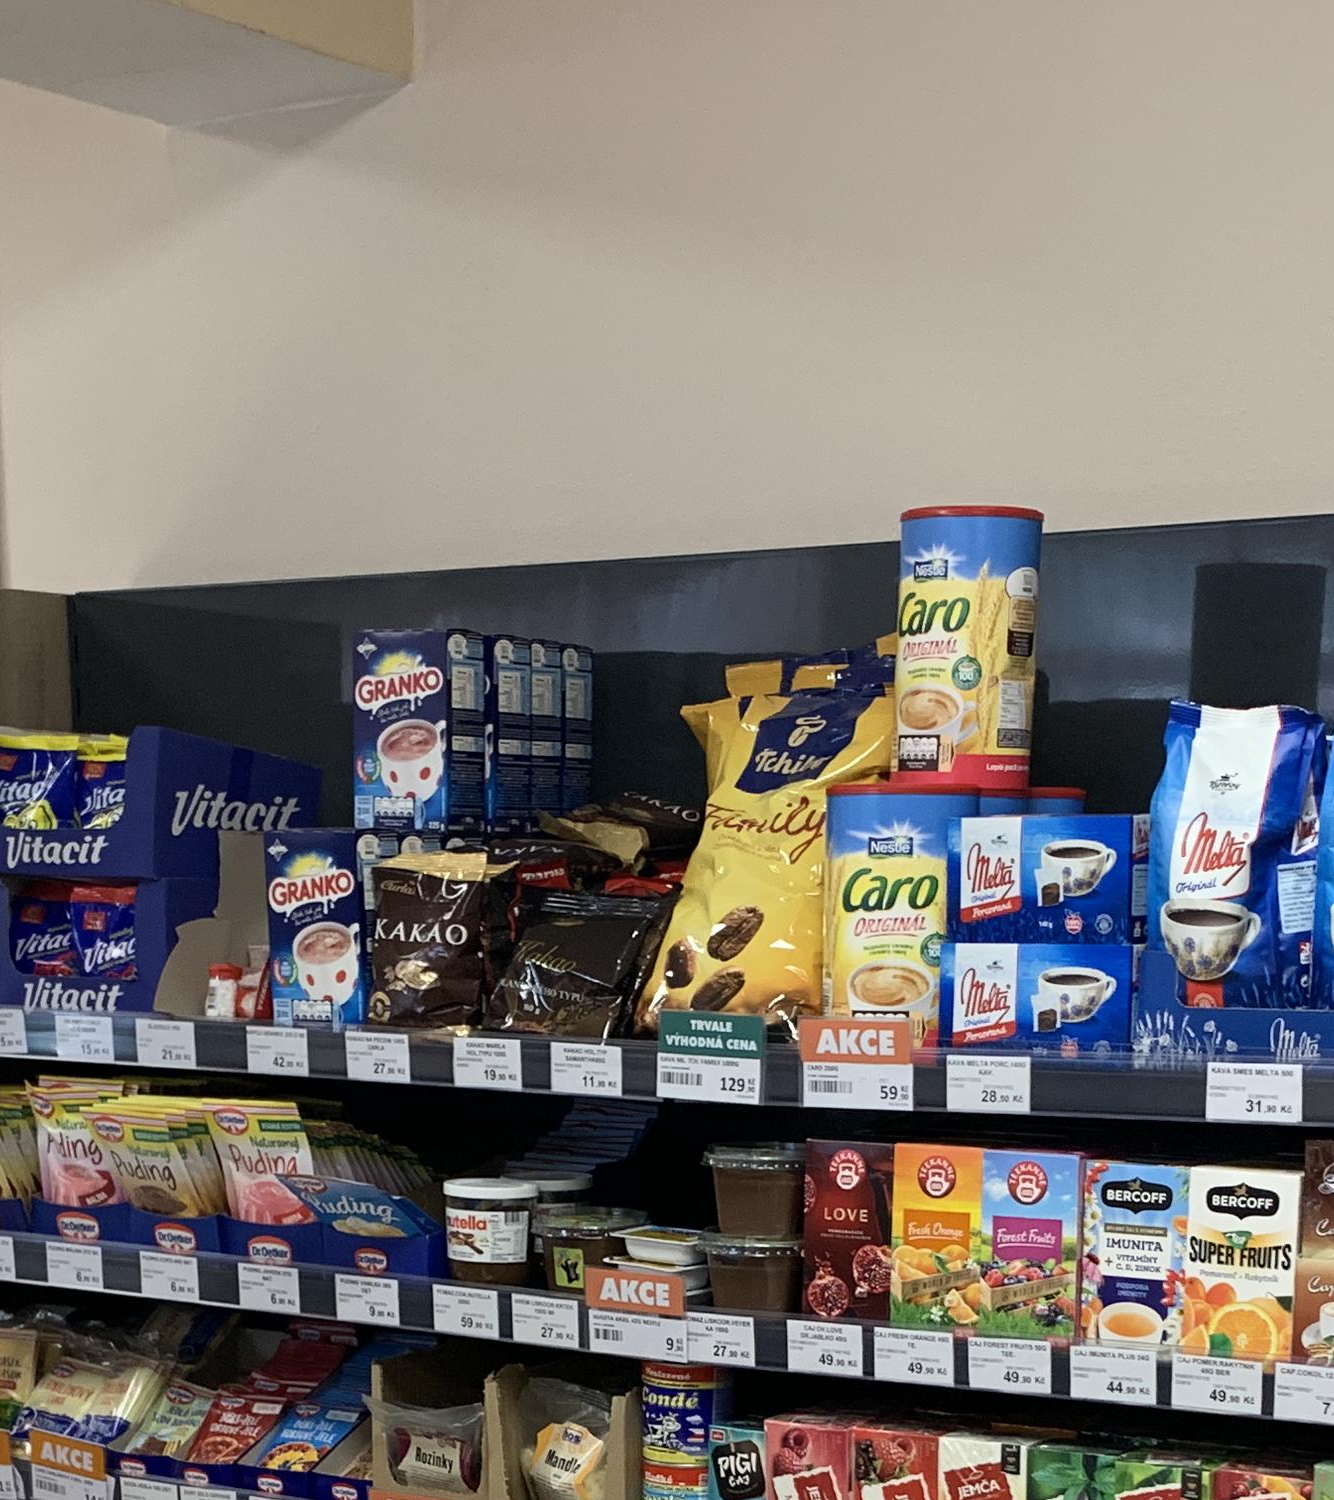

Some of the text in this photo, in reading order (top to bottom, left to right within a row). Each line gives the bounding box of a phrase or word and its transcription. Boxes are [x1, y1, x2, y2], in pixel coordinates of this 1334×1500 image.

[898, 592, 969, 636] Caro
[903, 637, 957, 661] ORIGINÁL
[358, 667, 441, 704] GRANKO
[171, 785, 300, 837] Vitacit
[706, 796, 826, 864] Family
[5, 834, 109, 870] Vitacit
[1181, 811, 1250, 887] Melta
[967, 842, 1015, 904] Melta
[271, 871, 353, 908] GRANKO
[842, 868, 939, 913] Caro
[375, 917, 466, 945] KAKAO
[854, 914, 927, 936] ORIGINÁL
[690, 1019, 733, 1034] TRVALE
[666, 1034, 757, 1052] VÝHODNÁ CENA
[816, 1029, 894, 1056] AKCE
[720, 1077, 745, 1092] 129
[1212, 1068, 1233, 1076] KAVA
[1235, 1068, 1254, 1076] SMES
[1256, 1069, 1278, 1077] MELTA
[880, 1085, 898, 1100] 59
[111, 1150, 175, 1191] Puding
[1106, 1189, 1167, 1204] BERCOFF
[1211, 1194, 1274, 1210] BERCOFF
[824, 1207, 868, 1223] LOVE
[908, 1221, 963, 1238] Fresh Orange
[996, 1229, 1056, 1245] Forest Fruits
[1106, 1237, 1163, 1253] IMUNITA
[1116, 1252, 1158, 1264] VITAMÍNY
[1189, 1235, 1292, 1271] SUPER FRUITS
[39, 1442, 94, 1470] AKCE
[414, 1446, 453, 1473] Rozinky
[546, 1448, 583, 1475] Mandle
[717, 1454, 758, 1479] PIGI
[956, 1477, 1002, 1500] JEMČA
